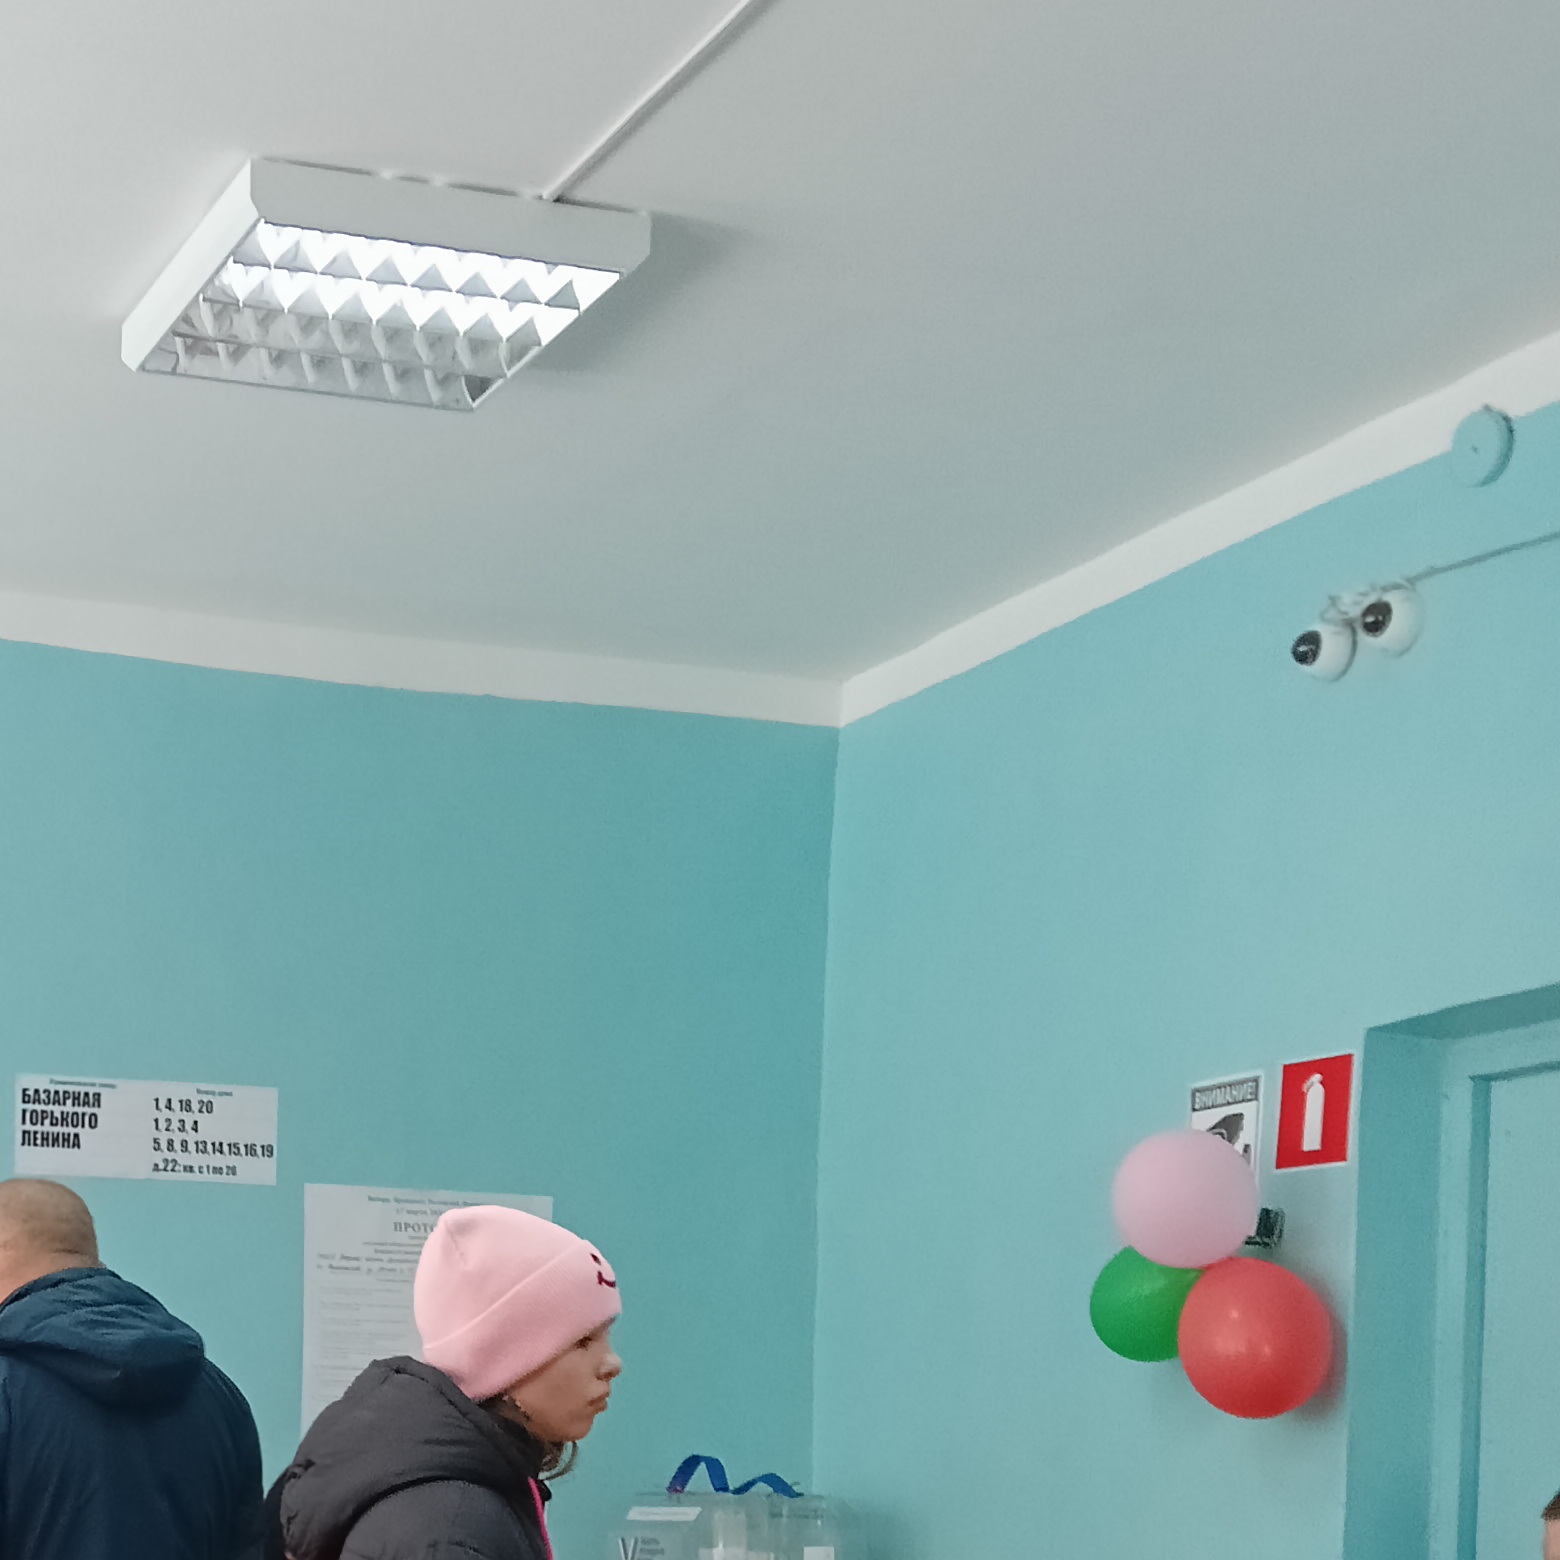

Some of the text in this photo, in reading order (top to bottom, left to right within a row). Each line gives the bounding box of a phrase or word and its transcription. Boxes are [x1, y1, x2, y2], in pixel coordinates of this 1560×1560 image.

[22, 1088, 101, 1109] БАЗАРНАЯ
[197, 1099, 214, 1114] 20
[21, 1108, 98, 1129] ГОРЬКОГО
[191, 1120, 198, 1133] 4
[21, 1130, 81, 1149] ЛЕНИНА
